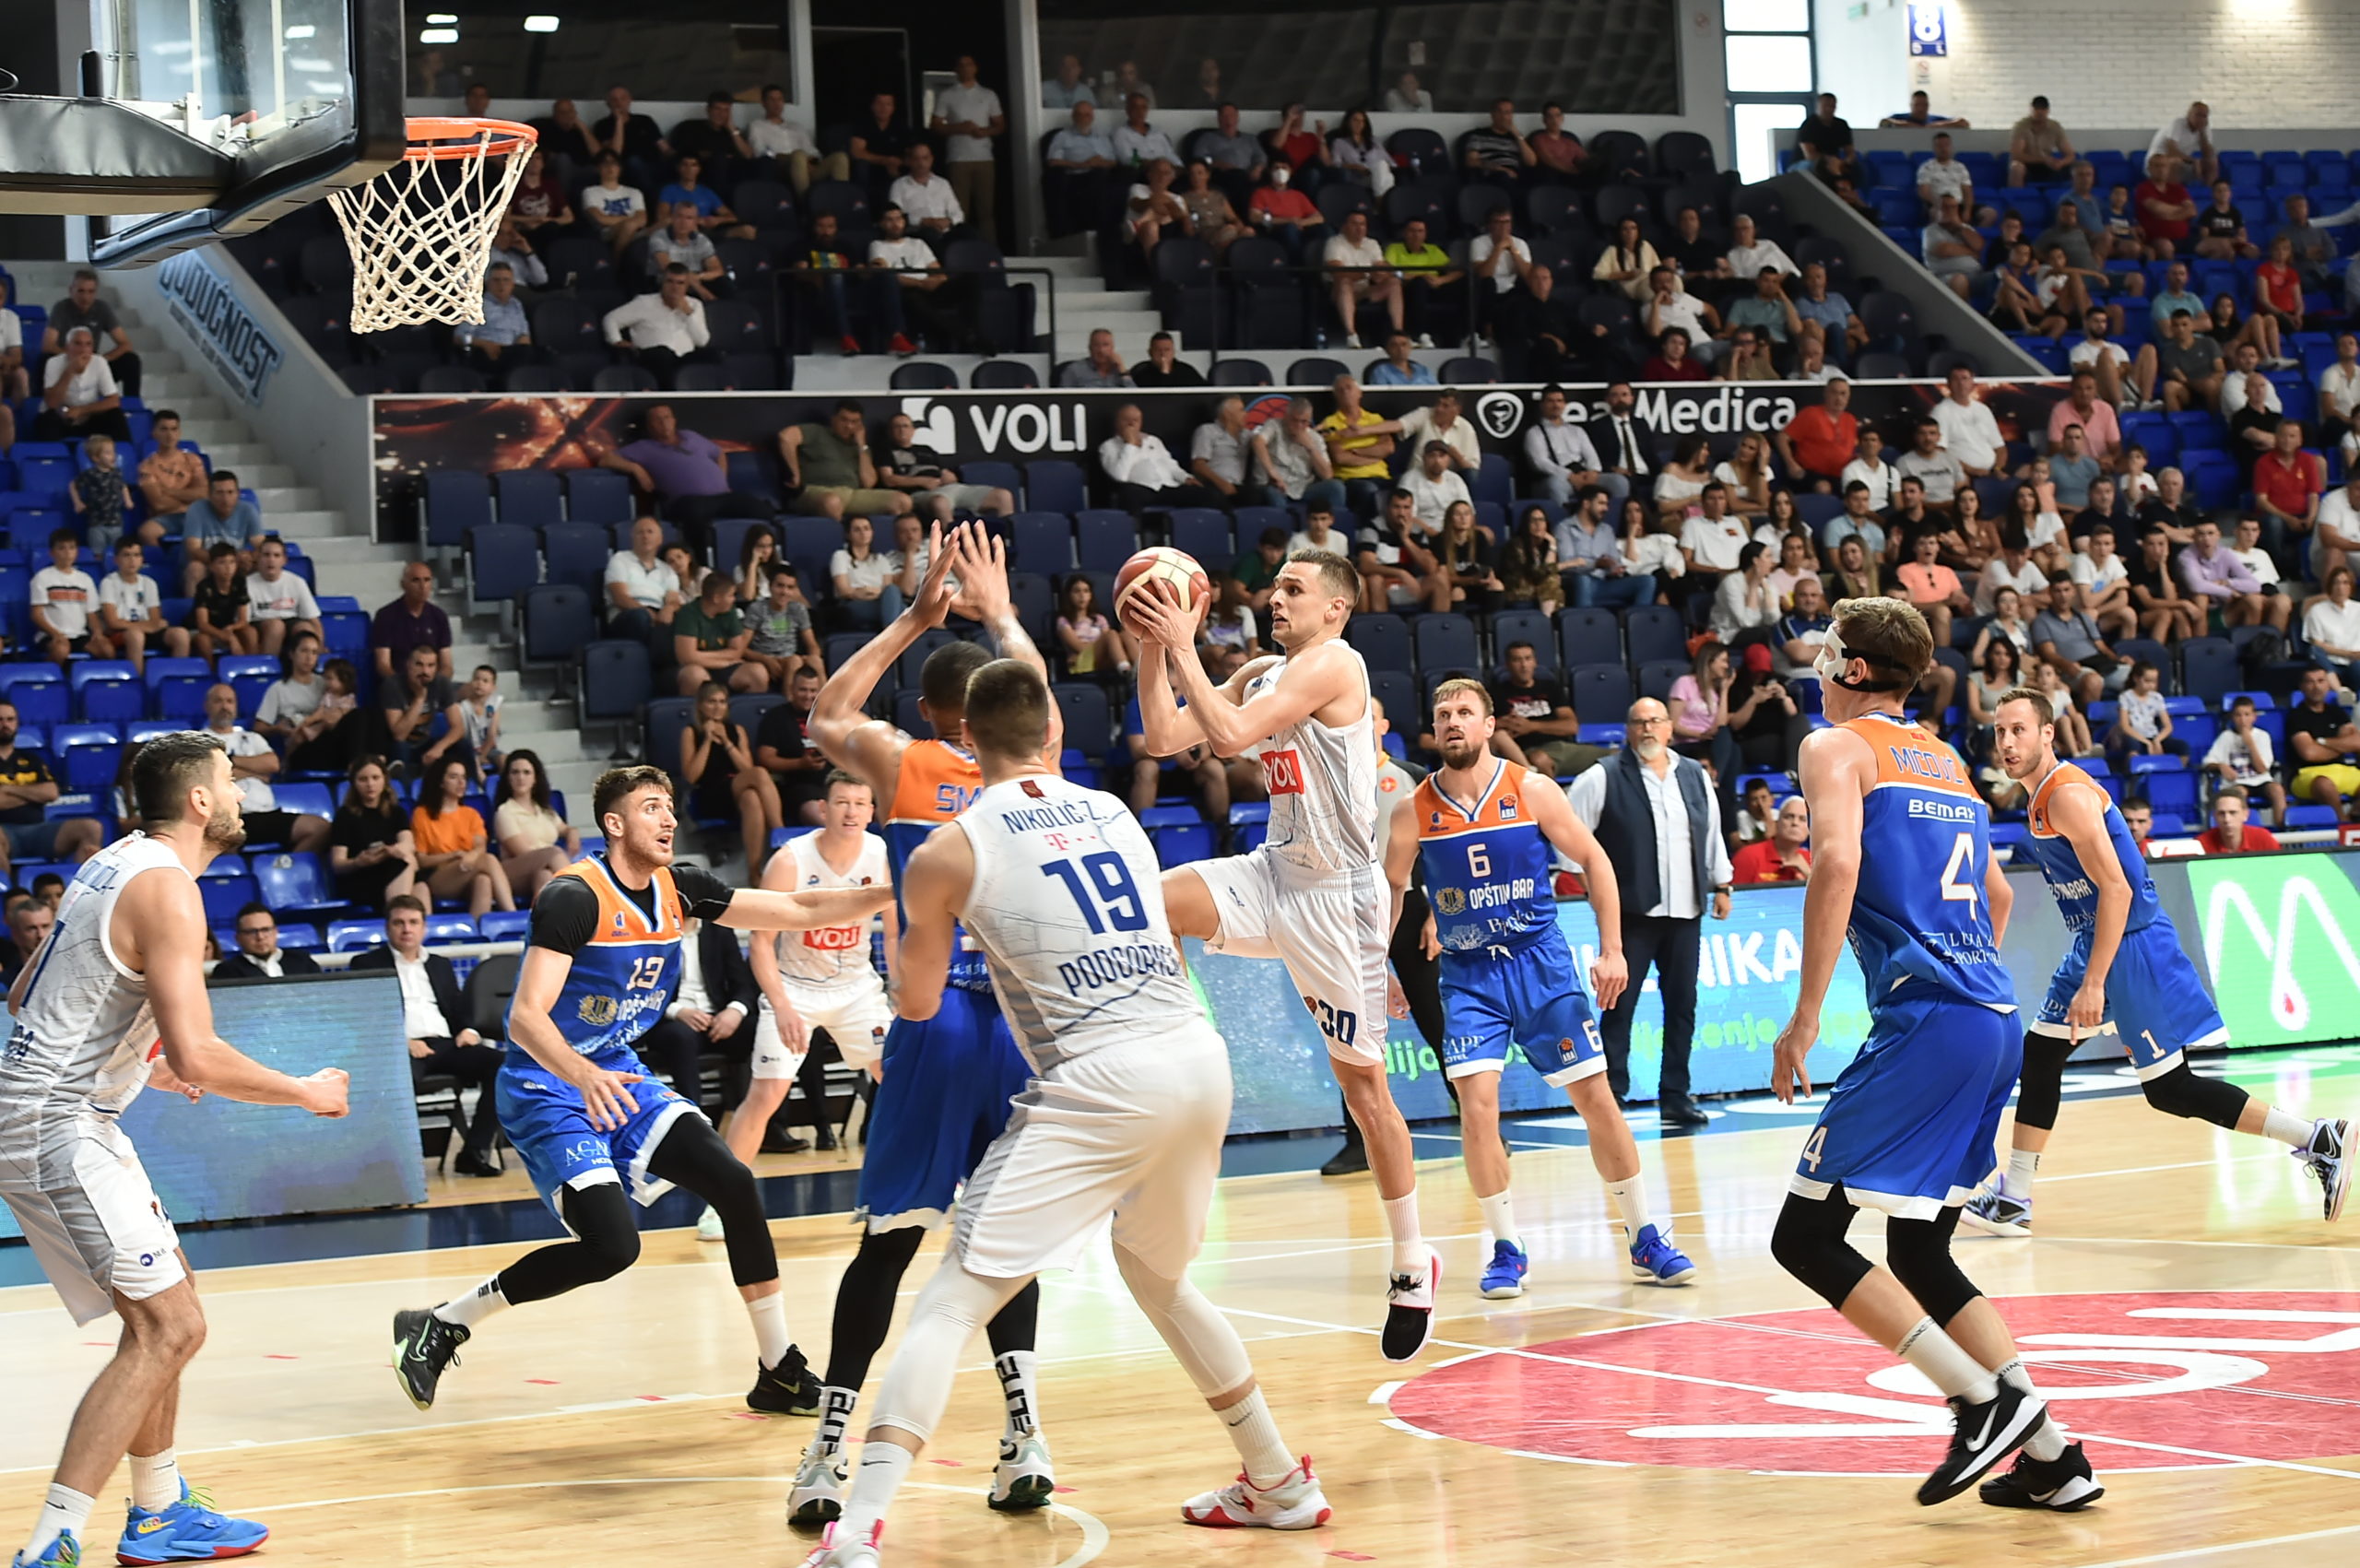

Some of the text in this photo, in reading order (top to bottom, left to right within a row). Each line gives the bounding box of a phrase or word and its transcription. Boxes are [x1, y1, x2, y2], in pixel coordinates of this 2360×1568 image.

[1914, 3, 1941, 42] 8
[970, 403, 1096, 454] VOLI
[1633, 387, 1797, 434] Medica
[1001, 799, 1085, 834] NIKOLIĆ
[1467, 843, 1492, 878] 6
[1940, 832, 1978, 922] 4
[1039, 850, 1149, 935] 19
[1512, 878, 1535, 901] BAR
[808, 925, 857, 948] VOLI
[627, 956, 665, 991] 13
[1317, 998, 1357, 1047] 30
[1581, 1019, 1602, 1053] 6
[2140, 1029, 2166, 1060] 1
[1802, 1126, 1828, 1173] 4
